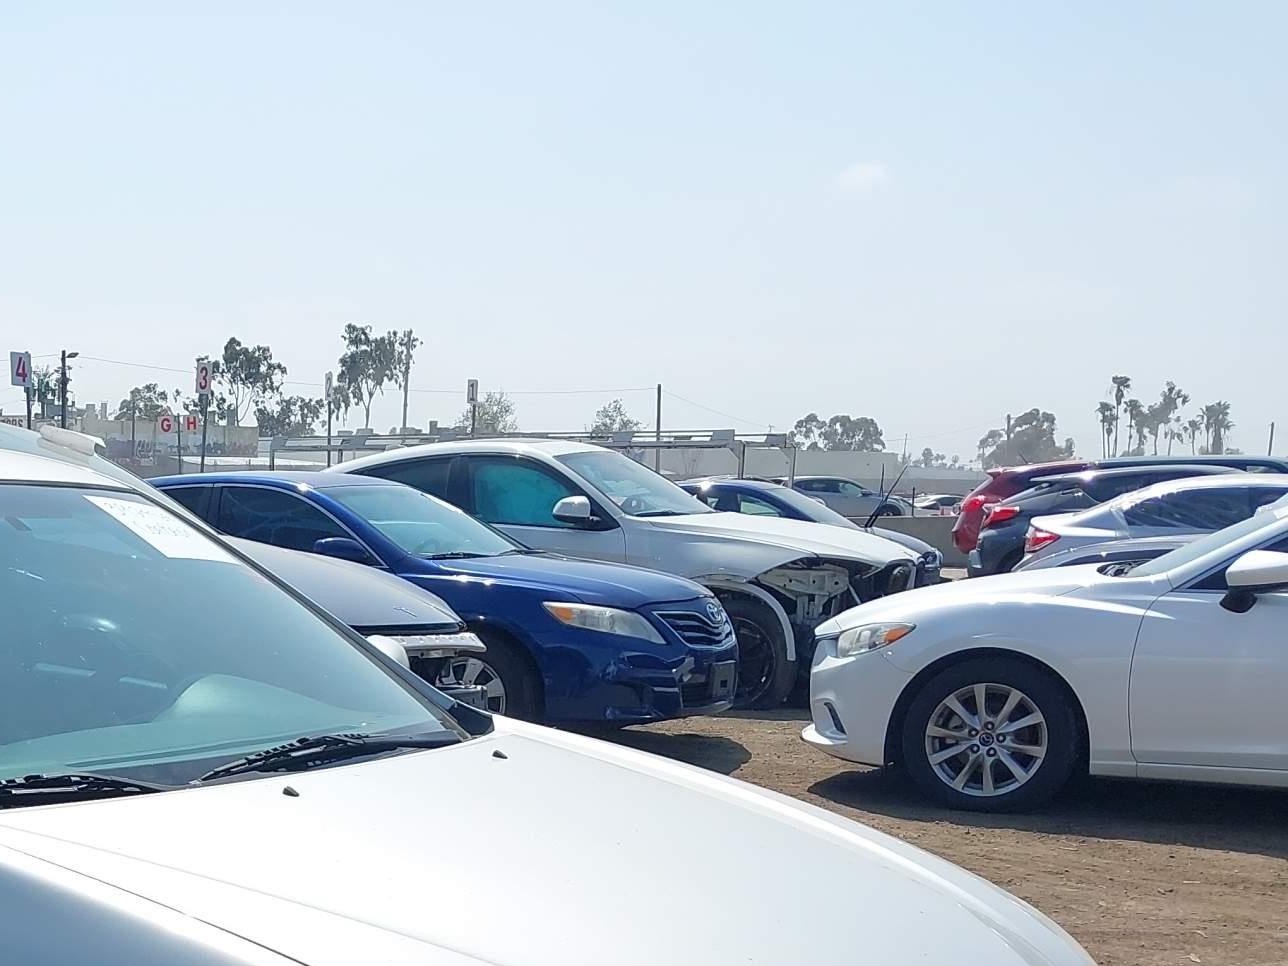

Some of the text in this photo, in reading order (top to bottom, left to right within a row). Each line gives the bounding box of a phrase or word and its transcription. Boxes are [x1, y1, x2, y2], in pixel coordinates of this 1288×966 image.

[15, 356, 28, 383] 4
[199, 366, 208, 390] 3
[469, 382, 476, 402] 1
[161, 417, 172, 433] G
[186, 415, 197, 431] H
